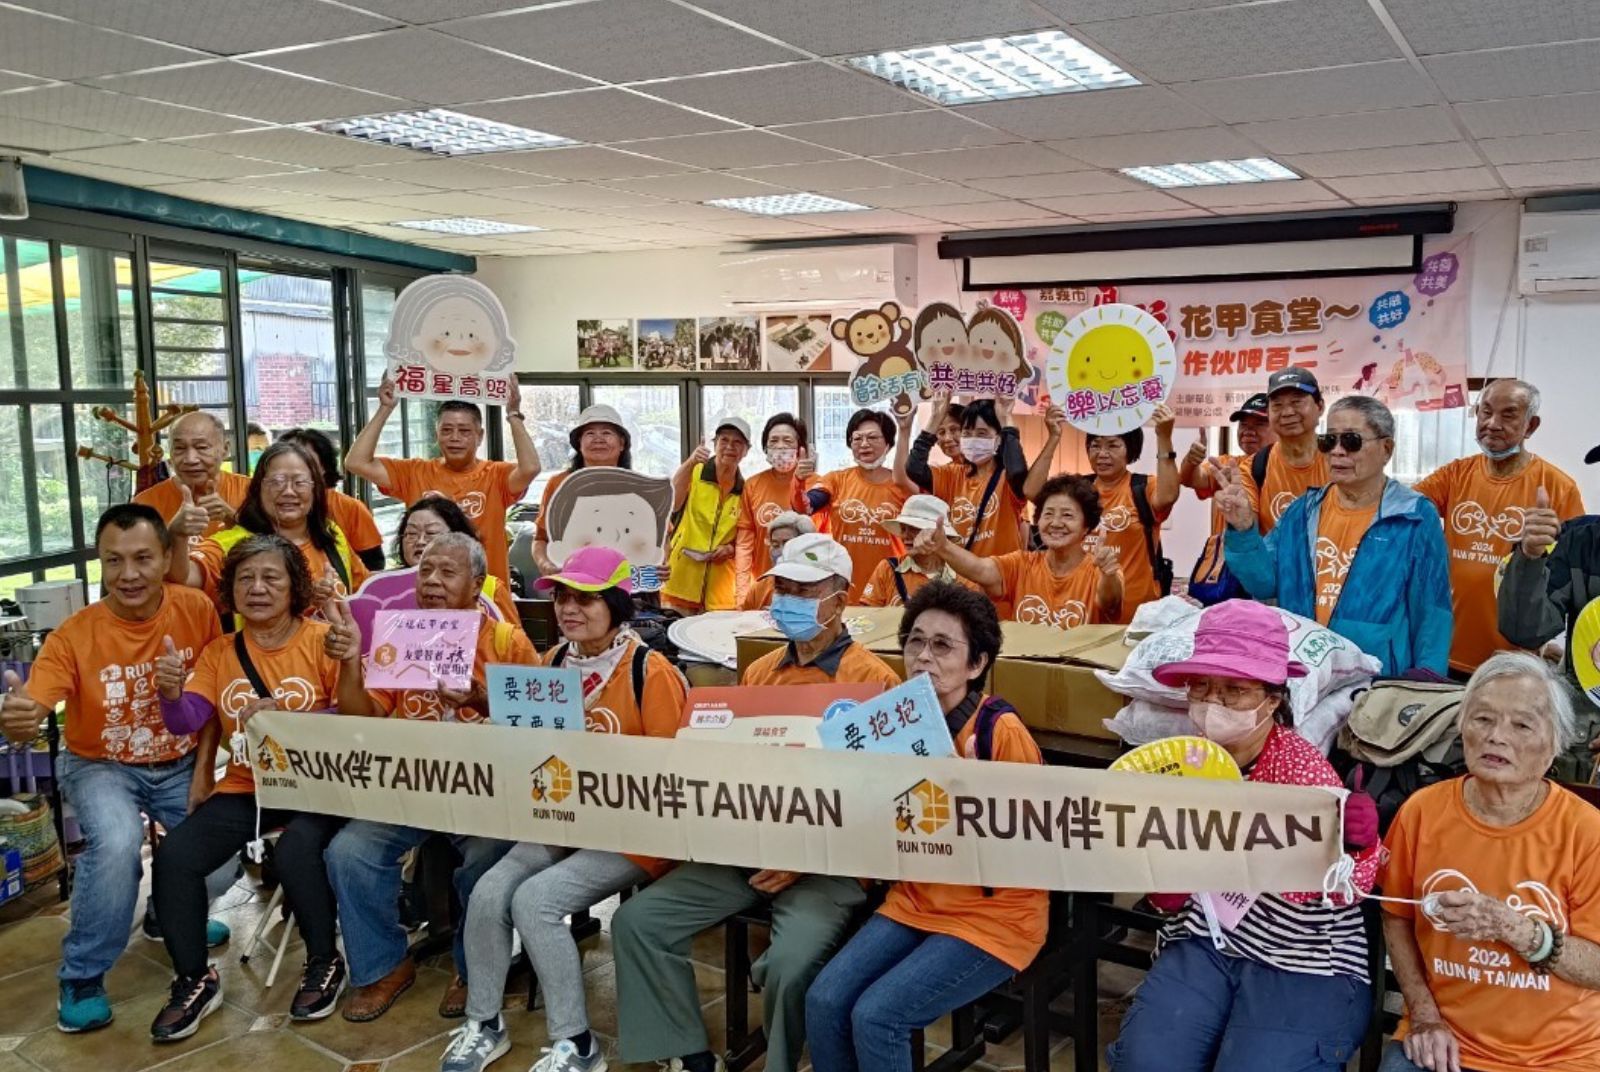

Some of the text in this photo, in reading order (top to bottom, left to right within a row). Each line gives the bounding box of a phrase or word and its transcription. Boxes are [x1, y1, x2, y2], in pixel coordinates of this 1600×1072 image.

[1183, 345, 1318, 376] 作伙呷百二
[396, 365, 507, 399] 福星高照
[853, 371, 927, 403] 齡活有
[930, 362, 1016, 394] 共生共好
[1471, 541, 1495, 553] 2024
[503, 676, 569, 705] 要抱抱
[843, 696, 922, 752] 要抱抱
[262, 776, 277, 787] RUN
[286, 748, 495, 797] RUN伴TAIWAN
[577, 770, 843, 828] RUN伴TAIWAN
[533, 807, 575, 823] RUN TOMO
[955, 795, 1323, 851] RUN伴TAIWAN
[896, 839, 953, 857] RUN TOMO
[1467, 946, 1511, 968] 2024
